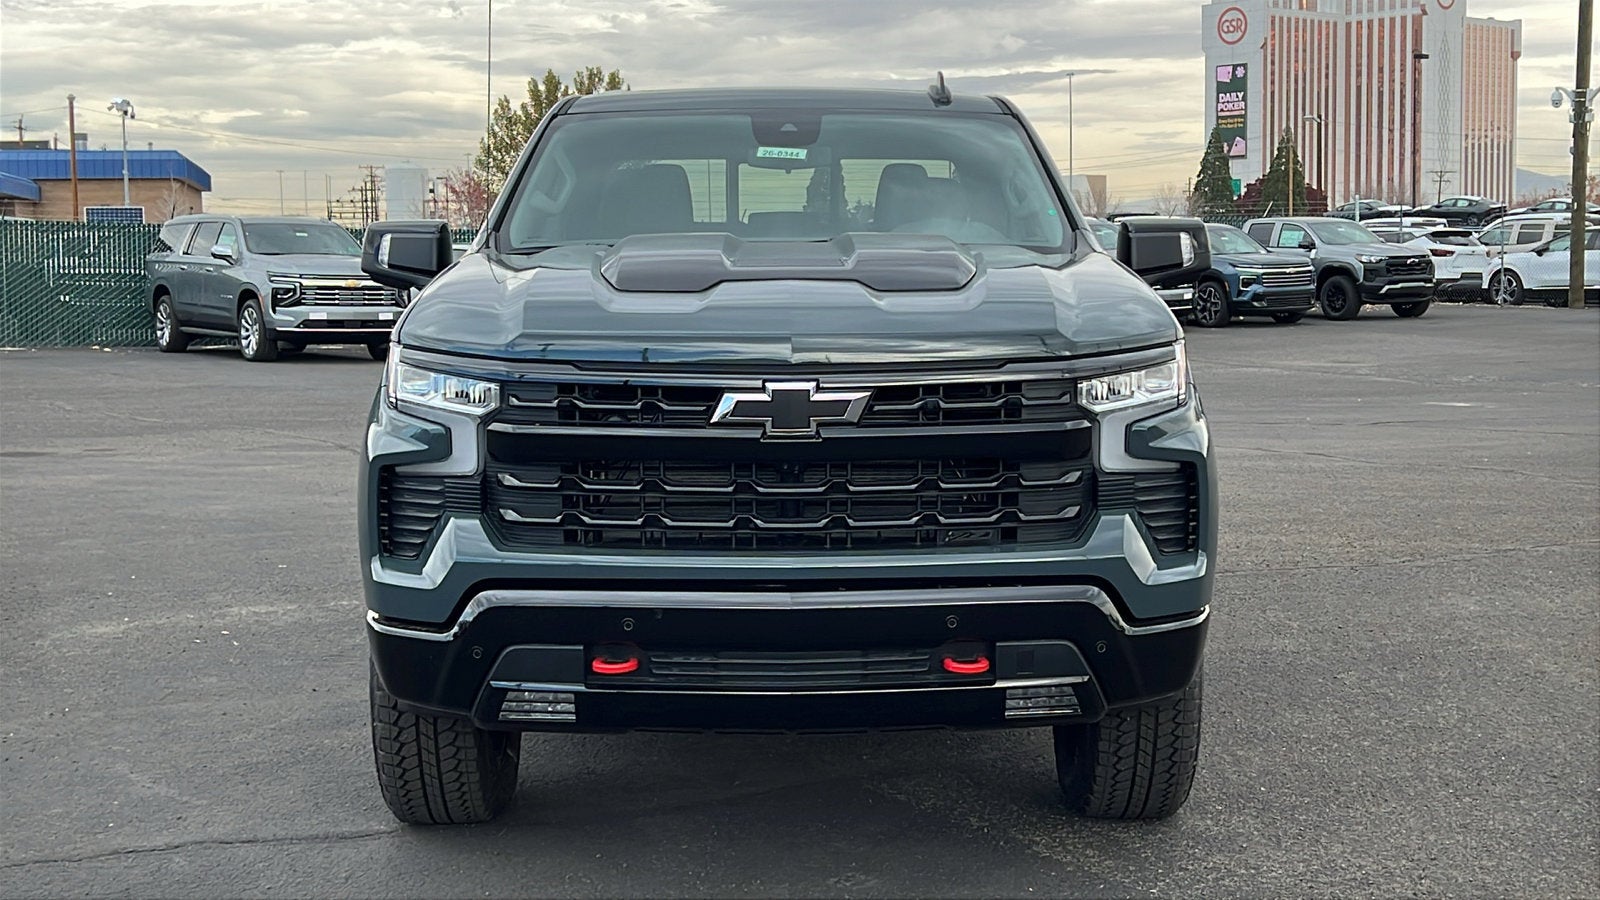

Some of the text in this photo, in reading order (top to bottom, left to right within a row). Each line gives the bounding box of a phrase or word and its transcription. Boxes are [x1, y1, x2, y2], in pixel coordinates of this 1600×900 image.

[1221, 17, 1243, 34] GSR
[1218, 92, 1244, 102] DAILY
[1217, 101, 1245, 111] POKER
